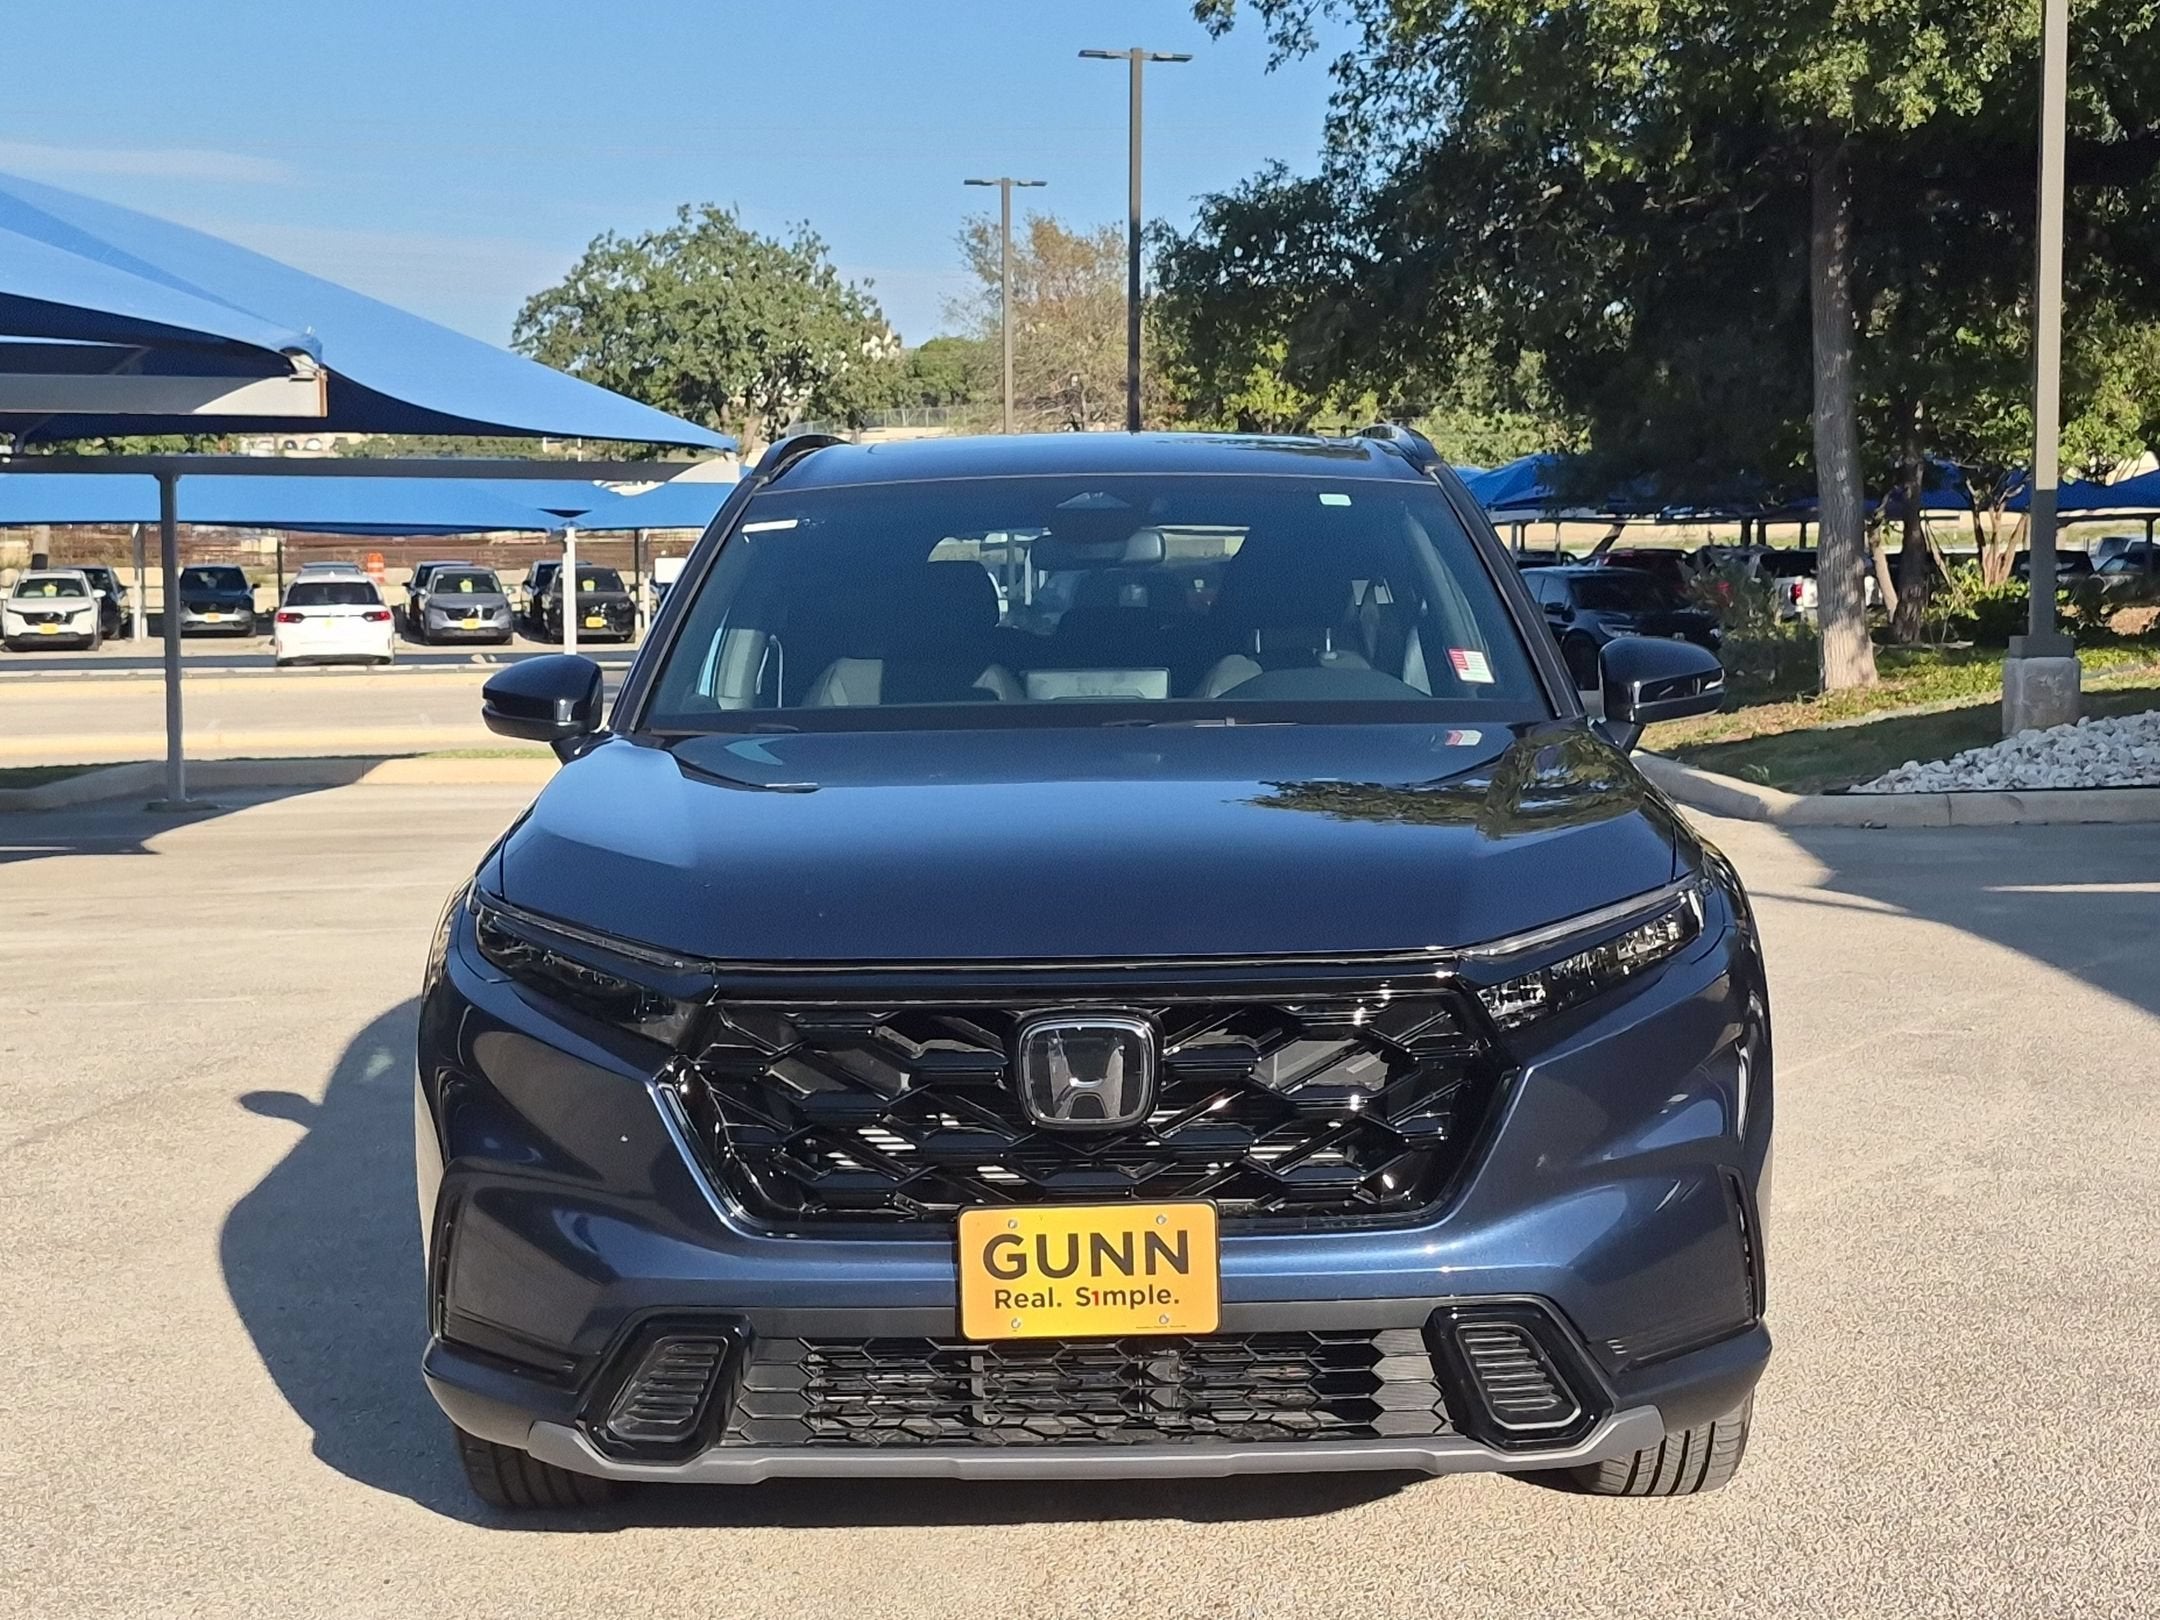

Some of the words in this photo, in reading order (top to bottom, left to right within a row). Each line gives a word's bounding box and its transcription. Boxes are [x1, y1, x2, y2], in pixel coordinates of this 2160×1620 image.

[983, 1230, 1189, 1280] GUNN
[995, 1287, 1062, 1310] Real.
[1076, 1284, 1180, 1310] S1mple.
